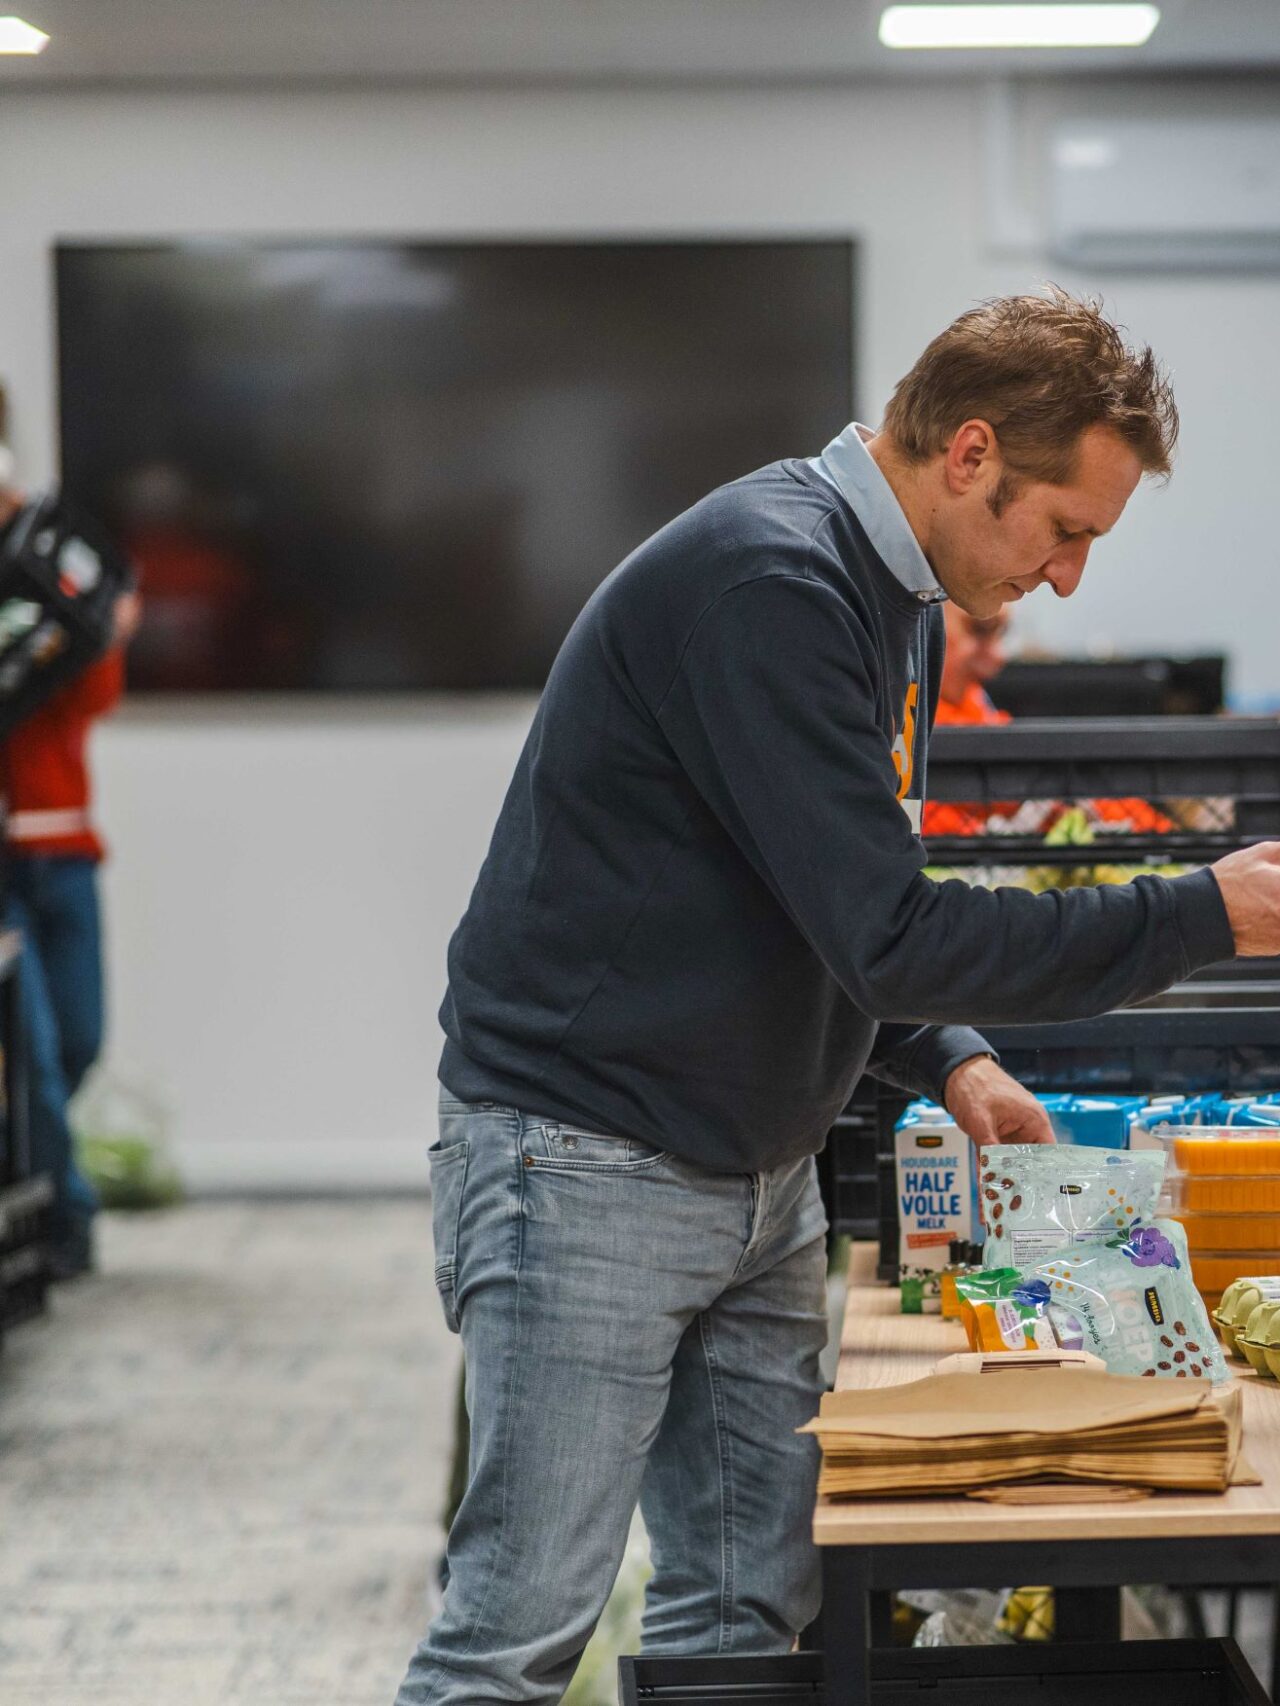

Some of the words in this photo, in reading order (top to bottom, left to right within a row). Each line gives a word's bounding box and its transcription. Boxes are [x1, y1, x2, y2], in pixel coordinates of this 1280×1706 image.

[901, 1157, 958, 1168] HOUDBARE
[906, 1172, 955, 1193] HALF
[902, 1195, 962, 1216] VOLLE
[917, 1218, 946, 1229] MELK
[1147, 1290, 1161, 1323] JUMBO
